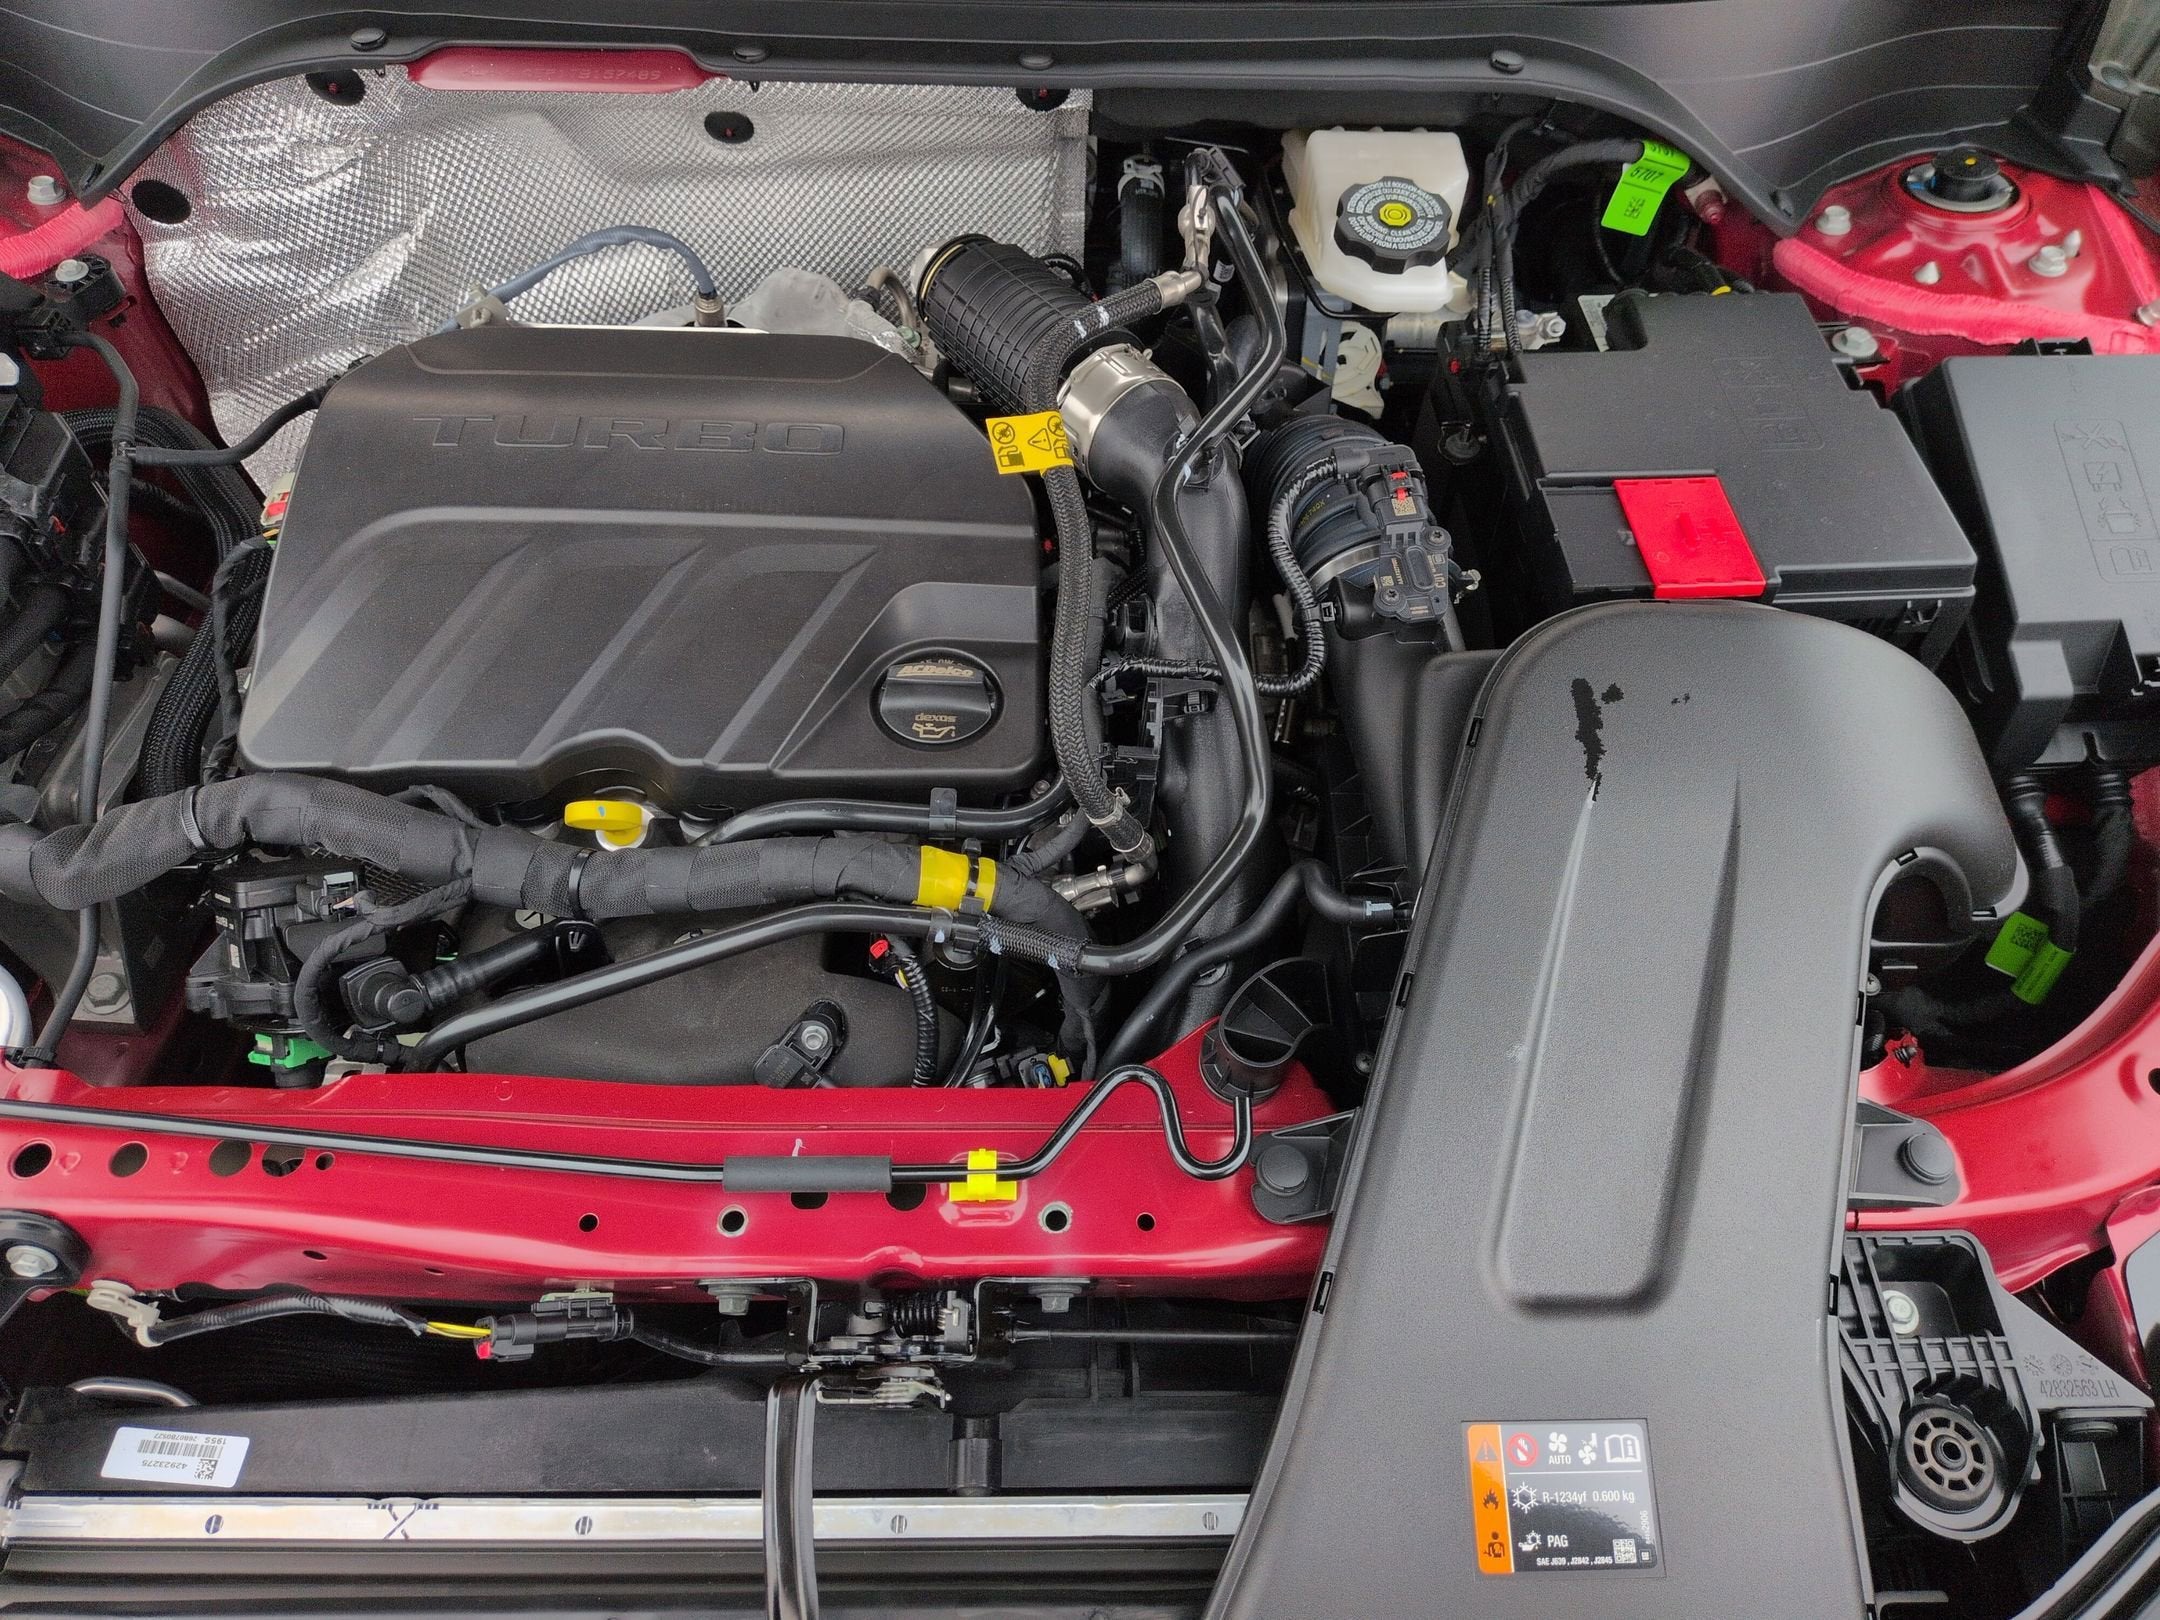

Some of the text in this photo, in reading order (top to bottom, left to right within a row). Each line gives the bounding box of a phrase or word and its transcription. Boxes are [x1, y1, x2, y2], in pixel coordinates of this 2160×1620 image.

[413, 415, 846, 456] TURBO
[896, 665, 974, 678] ACDelco
[914, 713, 958, 723] dexos
[2040, 1379, 2120, 1398] 42832563 LH
[142, 1459, 188, 1470] 42923275
[1548, 1455, 1572, 1465] AUTO
[1542, 1490, 1635, 1504] R-1234yf 0.600 kg
[1547, 1534, 1569, 1548] PAG
[1536, 1557, 1550, 1566] SAE
